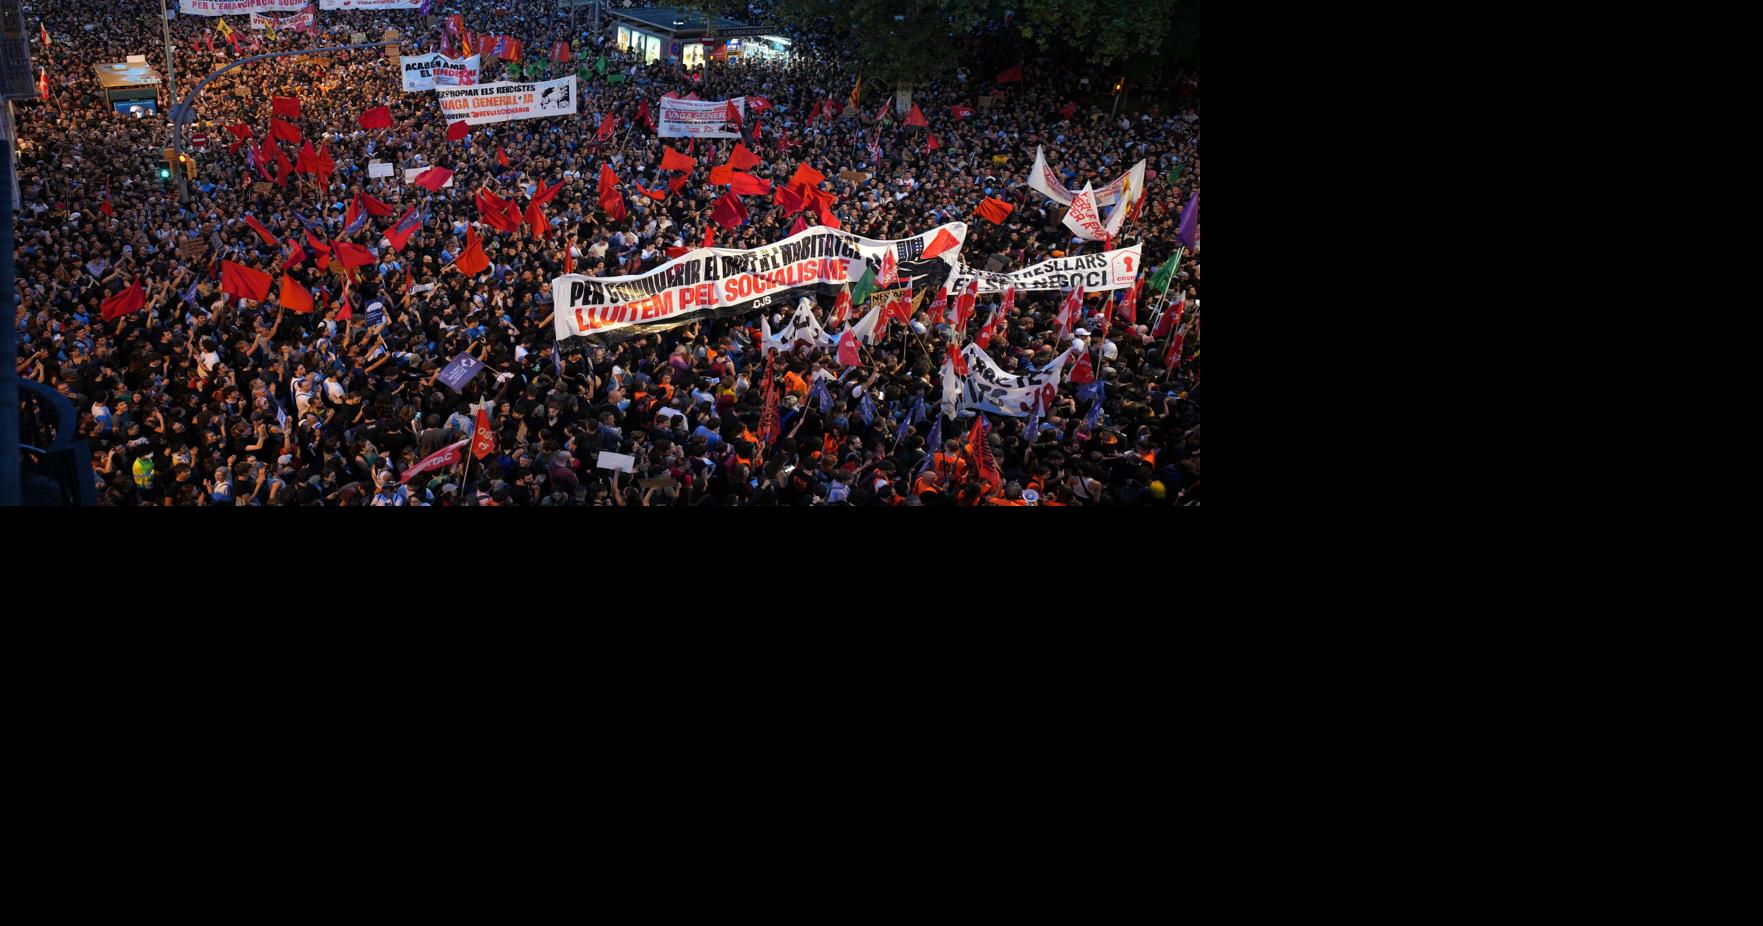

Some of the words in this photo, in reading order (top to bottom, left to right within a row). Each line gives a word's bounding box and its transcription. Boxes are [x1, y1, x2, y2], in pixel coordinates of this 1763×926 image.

[420, 69, 432, 78] EL
[481, 87, 495, 96] ELS
[441, 98, 470, 111] VAGA
[472, 95, 518, 108] GENERAL
[695, 112, 727, 120] GENER
[1054, 253, 1108, 272] LLARS
[570, 280, 605, 308] PER
[605, 258, 702, 302] CONQUERIR
[704, 255, 721, 281] EL
[1030, 270, 1108, 289] NEGOCI
[575, 290, 675, 332] LLUITEM
[678, 282, 719, 311] PEL
[724, 258, 851, 303] SOCIALISME
